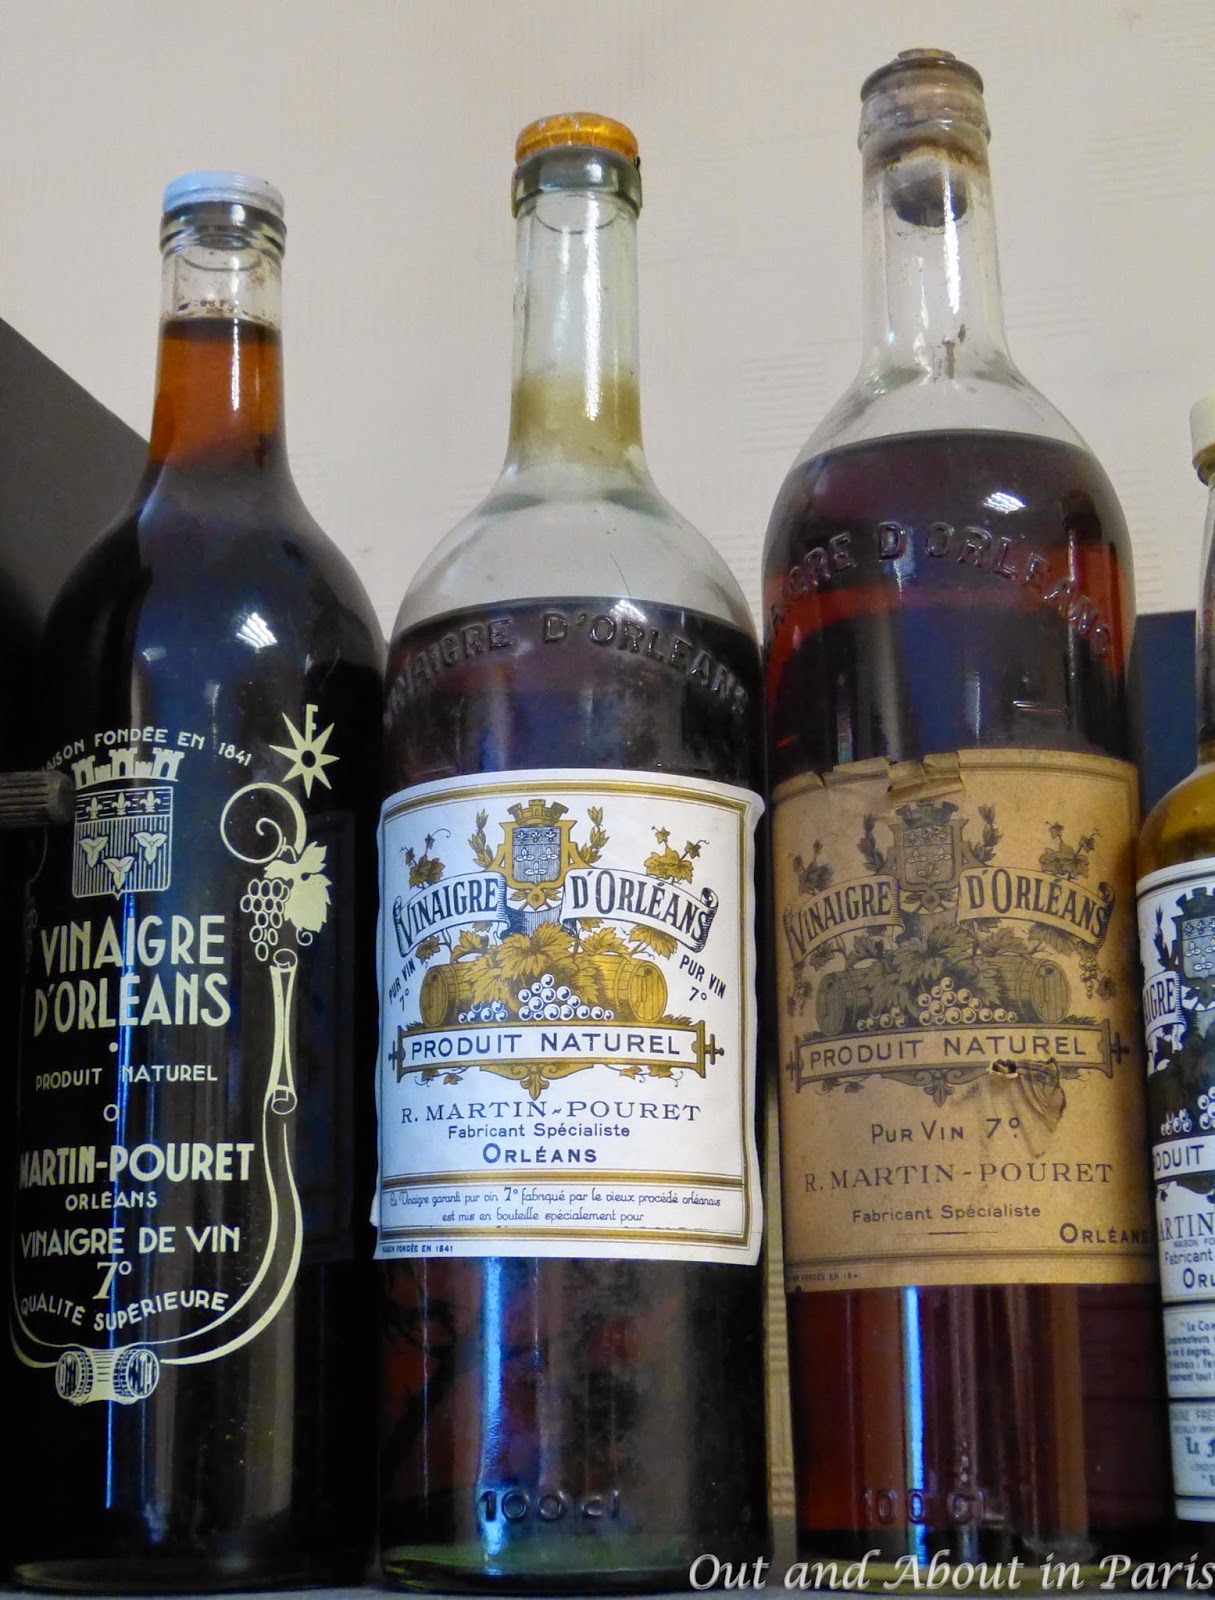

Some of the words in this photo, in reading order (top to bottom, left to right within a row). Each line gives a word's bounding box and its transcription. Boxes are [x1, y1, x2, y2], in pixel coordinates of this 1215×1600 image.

[42, 738, 85, 771] AISON
[94, 726, 167, 747] FONDÉE
[177, 731, 205, 750] EN
[218, 742, 252, 766] 1841
[396, 877, 500, 946] VINAIGRE
[571, 869, 709, 941] D'ORLÉANS
[788, 880, 893, 956] VINAIGRE
[966, 868, 1108, 936] D'ORLÉANS
[40, 915, 225, 977] VINAIGRE
[388, 979, 401, 1002] PUR
[402, 957, 416, 983] VIN
[678, 954, 705, 985] PUR
[708, 973, 726, 1000] VIN
[688, 987, 707, 1002] 7°
[411, 1033, 522, 1060] PRODUIT
[540, 1033, 681, 1055] NATUREL
[810, 1038, 924, 1071] PRODUIT
[943, 1035, 1086, 1057] NATUREL
[35, 1067, 103, 1091] PRODUIT
[122, 1064, 218, 1083] NATUREL
[401, 1106, 419, 1124] R.
[426, 1099, 701, 1122] MARTIN-POURET
[448, 1122, 525, 1139] Fabricant
[533, 1122, 631, 1139] Spécialiste
[19, 1142, 255, 1191] MARTIN-POURET
[482, 1142, 598, 1164] ORLÉANS
[464, 1194, 480, 1207] pur
[503, 1186, 519, 1203] 7°
[521, 1187, 566, 1206] fabriqué
[569, 1193, 588, 1206] par
[591, 1187, 602, 1201] le
[638, 1189, 679, 1206] procédé
[805, 1173, 824, 1193] R.
[441, 1209, 456, 1223] est
[458, 1211, 476, 1222] mis
[479, 1212, 493, 1222] en
[496, 1206, 540, 1221] bouteille
[544, 1206, 617, 1224] spécialement
[620, 1212, 645, 1224] pour
[853, 1204, 932, 1223] Fabricant
[940, 1203, 1041, 1222] Spécialiste
[20, 1227, 125, 1259] VINAIGRE
[138, 1226, 176, 1254] DE
[186, 1224, 240, 1253] VIN
[421, 1244, 432, 1253] EN
[435, 1244, 453, 1253] 1841
[92, 1260, 133, 1300] 7°
[20, 1291, 86, 1327] QUALITÉ
[93, 1288, 230, 1333] SUPÉRIEURE
